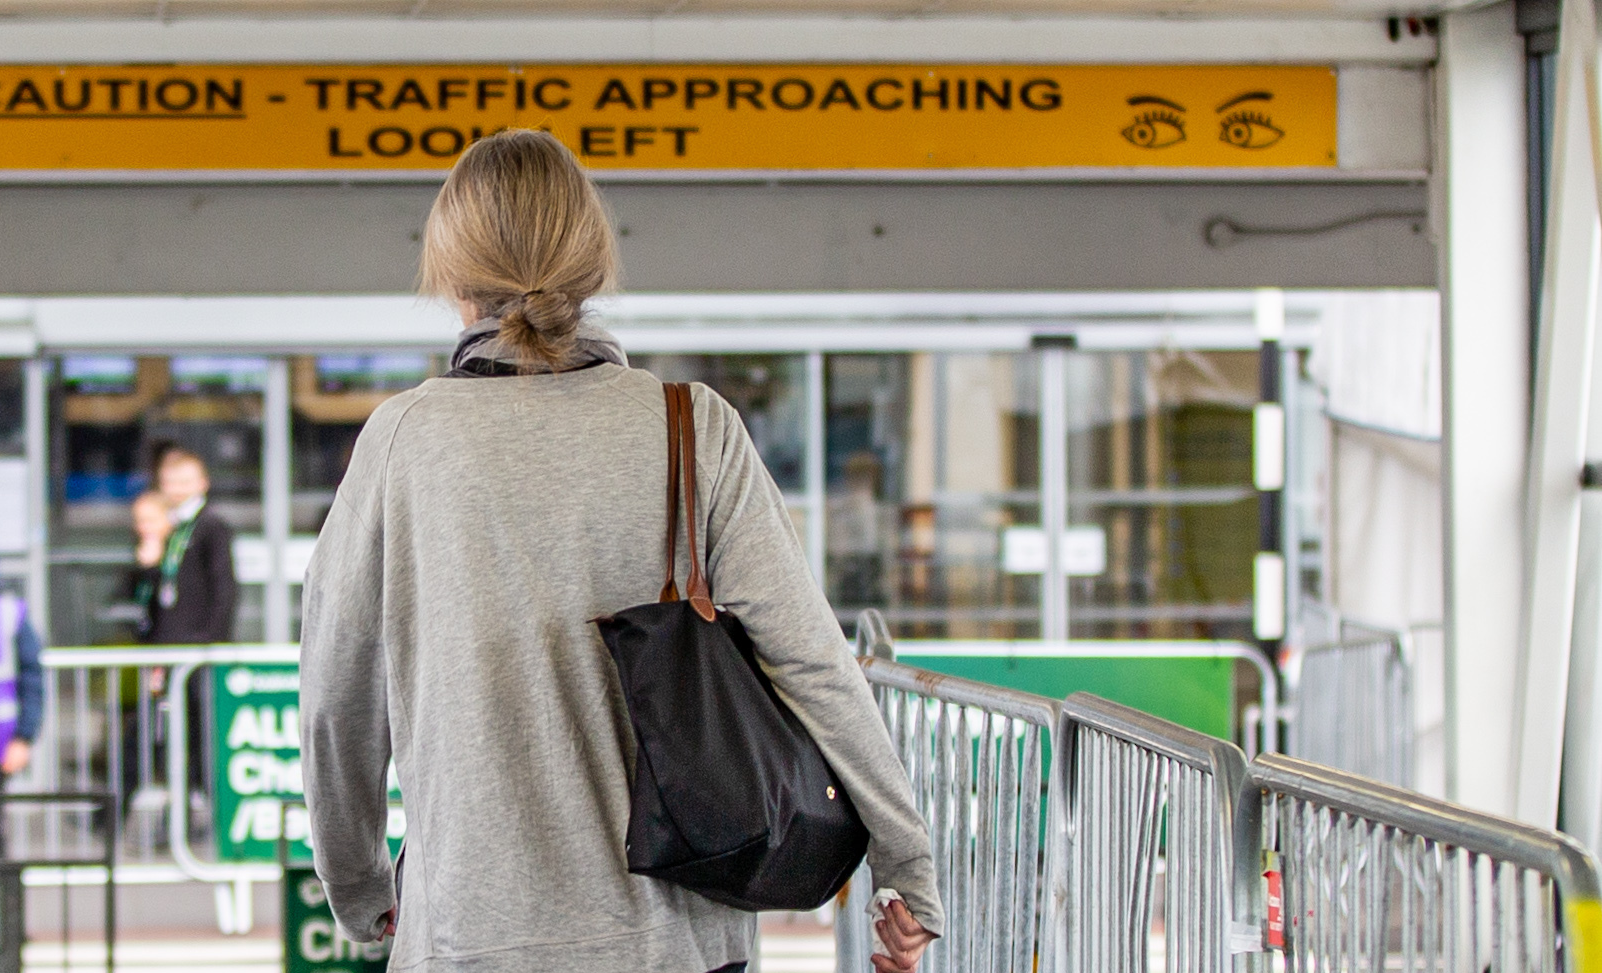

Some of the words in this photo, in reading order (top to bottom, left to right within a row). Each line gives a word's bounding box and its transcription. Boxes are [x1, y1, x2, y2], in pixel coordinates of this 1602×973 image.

[305, 78, 573, 112] TRAFFIC
[594, 78, 1063, 112] APPROACHING
[542, 126, 700, 156] EFT
